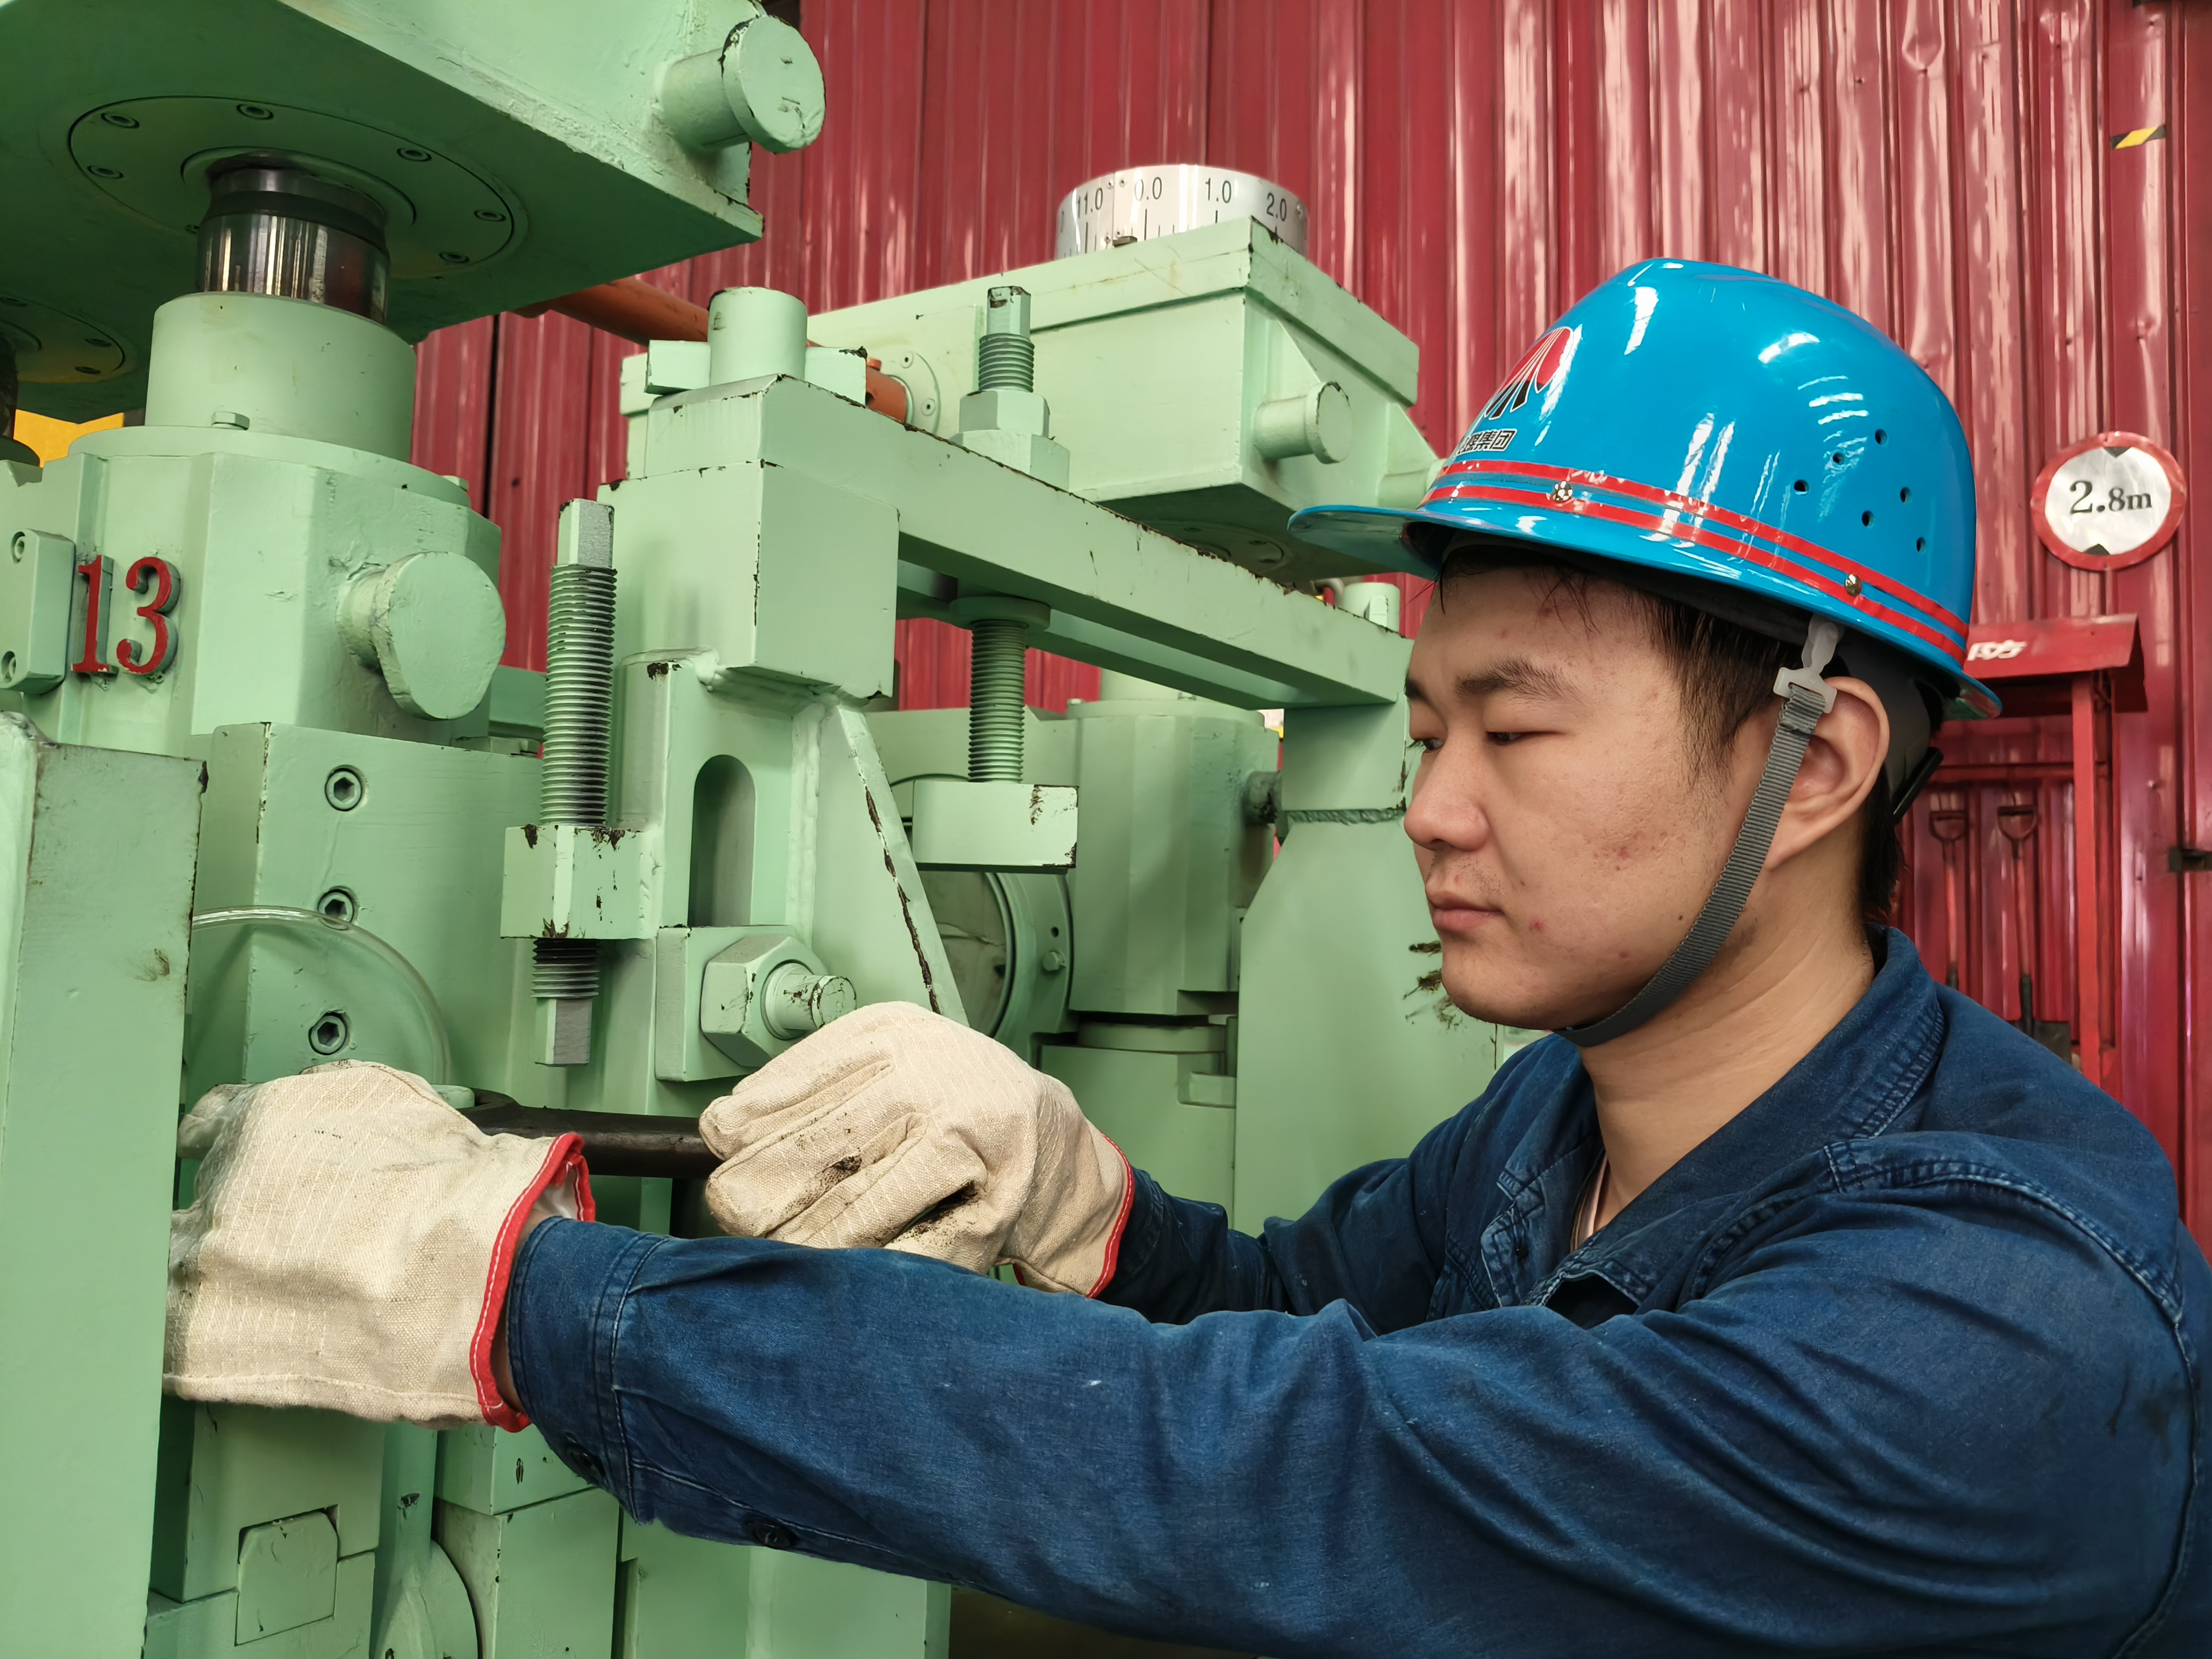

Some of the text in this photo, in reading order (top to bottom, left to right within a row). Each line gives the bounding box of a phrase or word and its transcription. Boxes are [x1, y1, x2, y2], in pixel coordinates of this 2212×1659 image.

[1134, 176, 1162, 201] 0.0
[1205, 177, 1232, 204] 1.0
[1266, 192, 1287, 222] 2.0
[2068, 480, 2153, 514] 2.8m
[71, 555, 178, 675] 13
